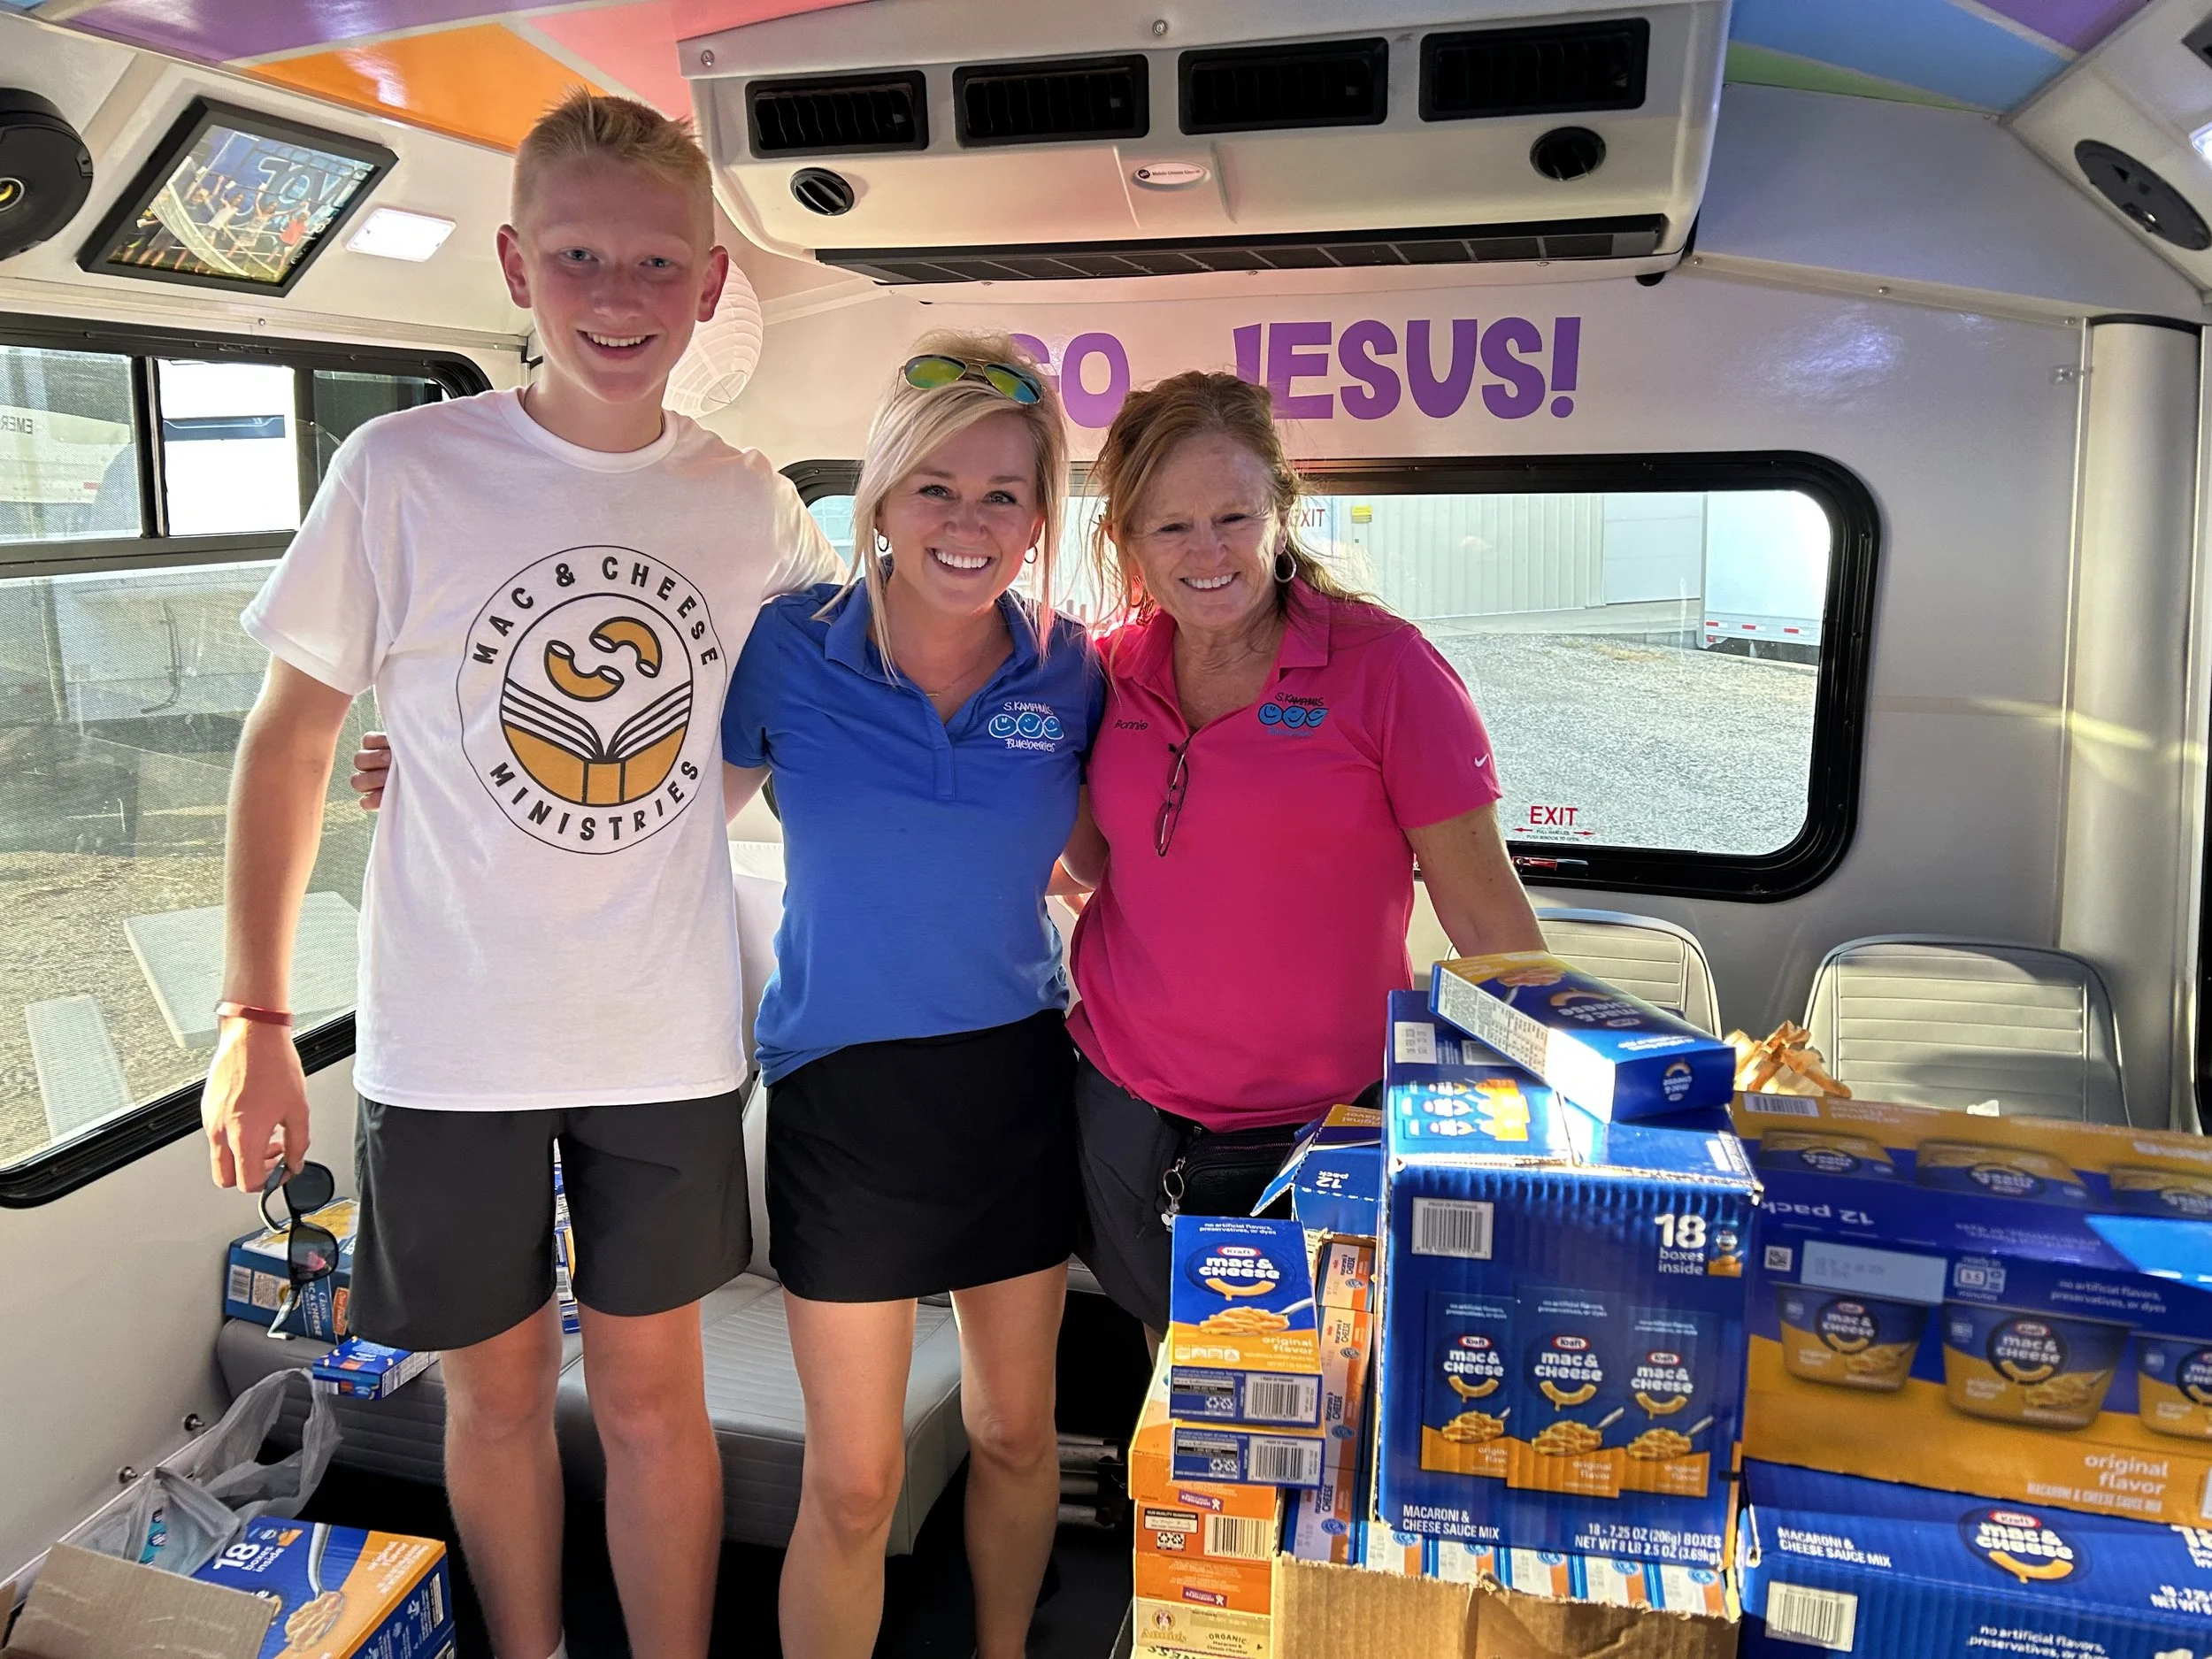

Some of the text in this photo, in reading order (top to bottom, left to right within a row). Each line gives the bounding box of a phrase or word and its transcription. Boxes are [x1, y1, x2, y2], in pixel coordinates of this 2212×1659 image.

[1233, 317, 1580, 420] JESUS!
[1297, 508, 1325, 527] XIT
[472, 557, 718, 665] MAC & CHEESE
[1114, 719, 1148, 731] Bonnie
[489, 761, 699, 841] MINISTRIES
[1530, 805, 1578, 826] EXIT
[1316, 1177, 1342, 1189] 12
[1318, 1171, 1349, 1180] pack
[1762, 1201, 1874, 1226] 12 pack
[1655, 1213, 1707, 1249] 18
[1205, 1256, 1274, 1270] mac &
[1659, 1248, 1704, 1263] boxes
[1658, 1261, 1704, 1276] inside
[1958, 1290, 1998, 1301] minutes
[2075, 1282, 2119, 1295] artificial
[2121, 1286, 2162, 1301] flavors,
[2051, 1292, 2126, 1310] preservatives,
[2140, 1301, 2166, 1314] dyes
[311, 1302, 322, 1336] CHEESE
[1826, 1313, 1872, 1327] mac &
[1262, 1337, 1313, 1347] original
[1273, 1343, 1314, 1355] flavor
[1465, 1337, 1487, 1347] Kraft
[1560, 1338, 1586, 1348] Kraft
[2002, 1335, 2057, 1353] mac &
[1449, 1349, 1500, 1364] mac &
[1541, 1352, 1598, 1369] mac &
[1637, 1366, 1689, 1381] mac &
[1580, 1470, 1610, 1480] flavor
[2085, 1453, 2168, 1479] original
[2099, 1471, 2167, 1495] flavor
[2027, 1481, 2072, 1500] MACARONI
[2082, 1488, 2115, 1507] CHEESE
[1402, 1503, 1470, 1523] MACARONI &
[2001, 1514, 2030, 1525] Kraft
[1402, 1517, 1500, 1541] CHEESE SAUCE MIX
[1588, 1523, 1601, 1535] 18
[1609, 1525, 1629, 1540] 7.25
[1632, 1527, 1647, 1540] OZ
[1684, 1532, 1721, 1549] BOXES
[1778, 1526, 1855, 1550] MACARONI &
[1979, 1522, 2062, 1547] mac &
[212, 1542, 260, 1571] 18
[1574, 1534, 1597, 1549] NET
[1598, 1536, 1617, 1551] WT
[1627, 1540, 1642, 1554] LB
[1644, 1541, 1660, 1556] 2.5
[1662, 1543, 1677, 1559] OZ
[1779, 1539, 1892, 1569] CHEESE SAUCE MIX
[242, 1546, 274, 1571] boxes
[255, 1548, 285, 1572] inside
[1209, 1632, 1248, 1645] ORGANIC
[1970, 1636, 2077, 1659] preservatives, or
[1980, 1624, 2106, 1655] no artificial flavors,
